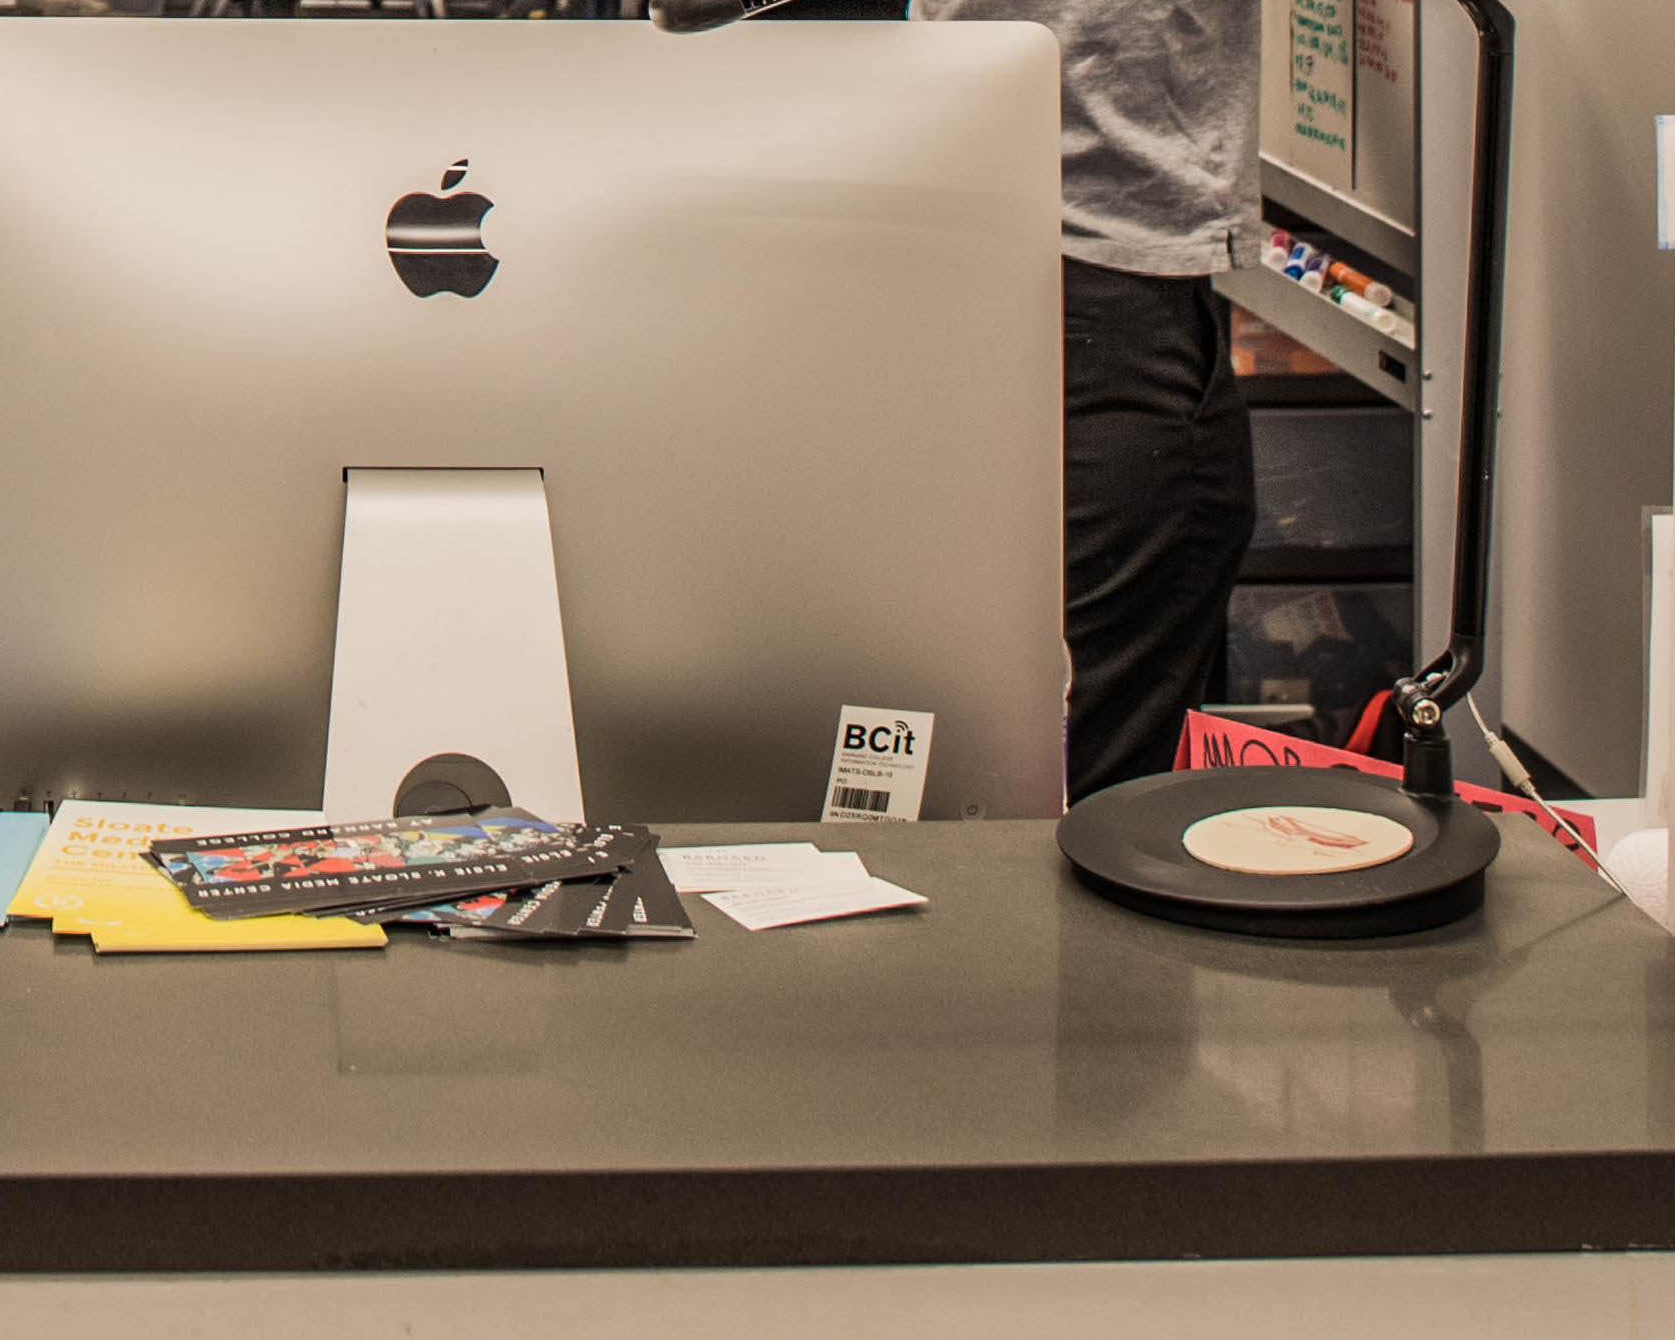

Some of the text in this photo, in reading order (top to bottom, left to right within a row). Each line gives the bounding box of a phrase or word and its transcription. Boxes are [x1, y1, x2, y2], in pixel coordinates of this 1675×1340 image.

[843, 723, 915, 755] BCit
[73, 817, 193, 833] Sloate
[301, 821, 398, 838] BARNARD
[69, 831, 161, 846] Med
[195, 831, 292, 847] COLLEGE
[347, 870, 420, 886] SLOATE
[452, 863, 508, 877] ELSIE
[197, 883, 272, 899] CENTER
[280, 877, 340, 891] MEDIA
